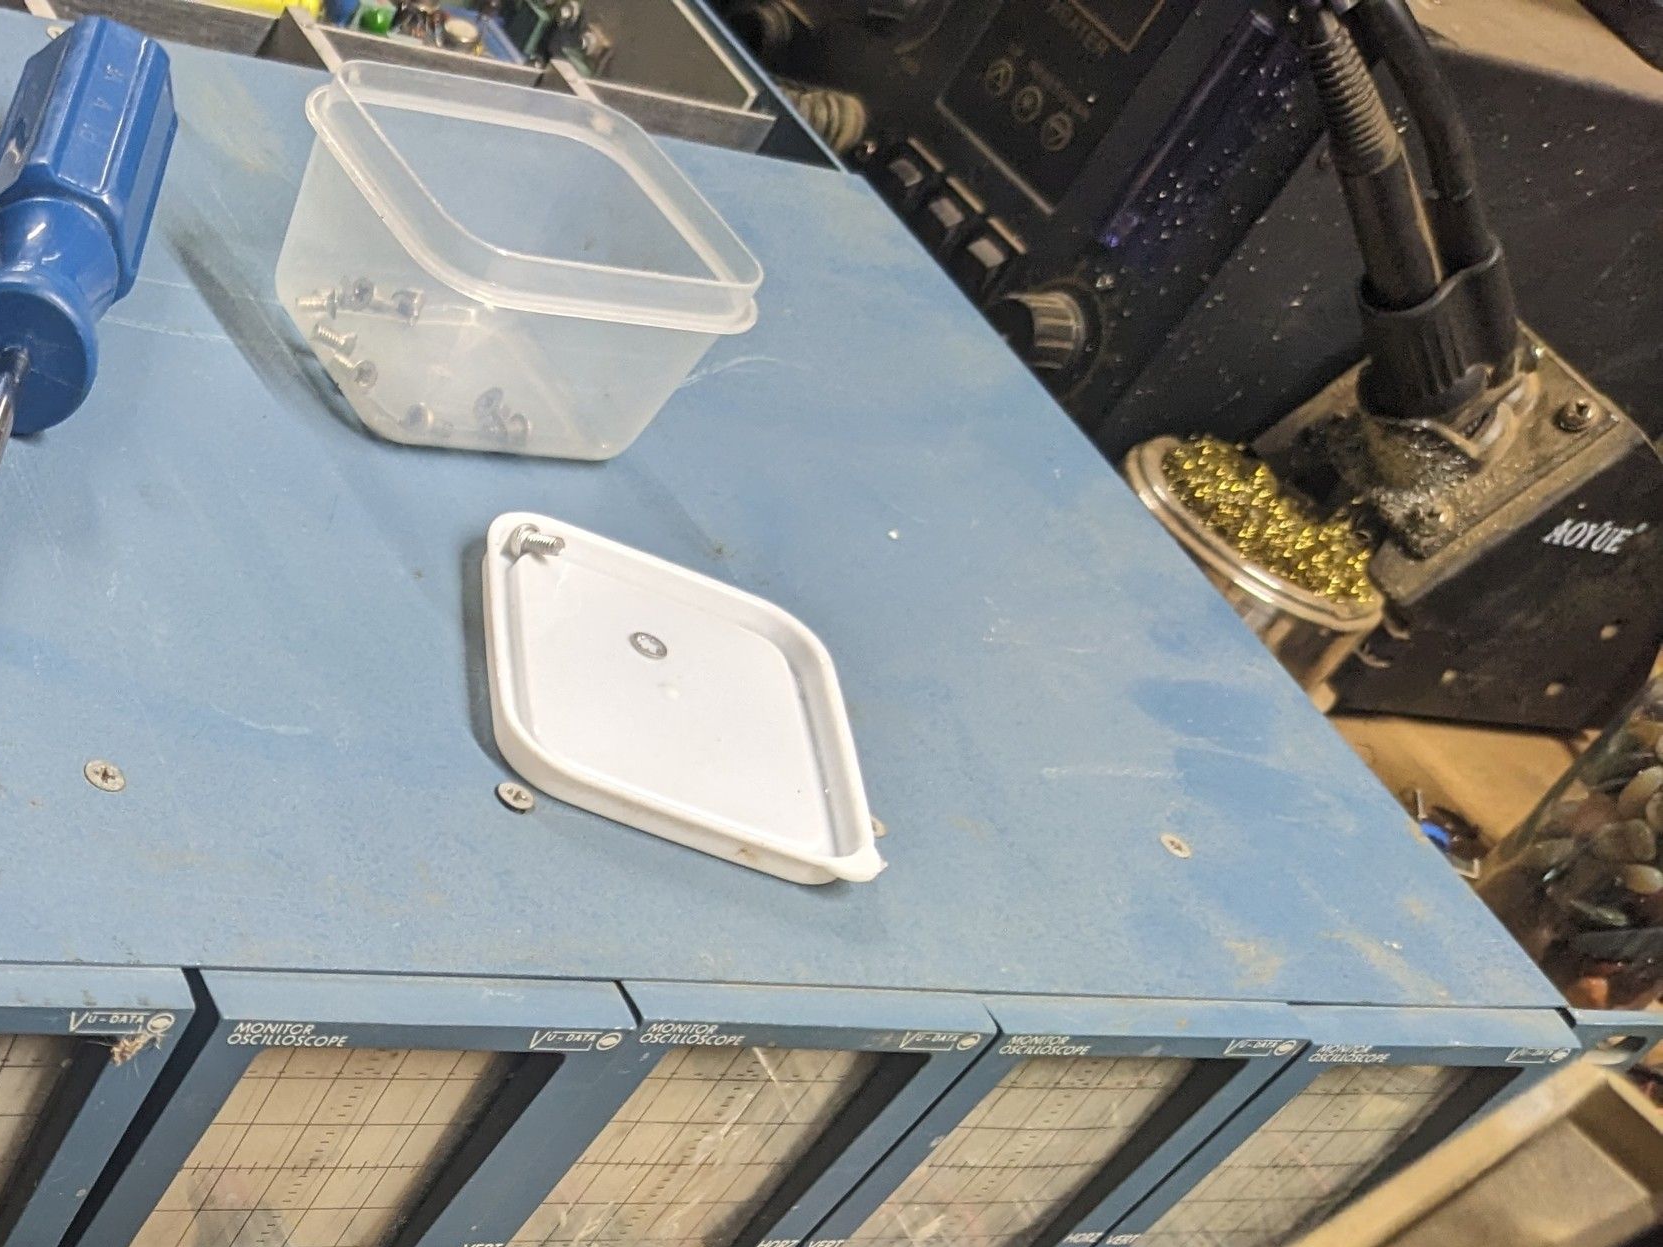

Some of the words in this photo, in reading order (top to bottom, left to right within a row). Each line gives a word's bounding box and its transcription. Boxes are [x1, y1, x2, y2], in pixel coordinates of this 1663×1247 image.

[1541, 518, 1634, 554] AOYUE
[236, 1022, 315, 1036] MONITOR
[649, 1023, 718, 1036] MONITOR
[227, 1033, 348, 1048] OSCILLOSCOPE
[639, 1033, 746, 1047] OSCILLOSCOPE
